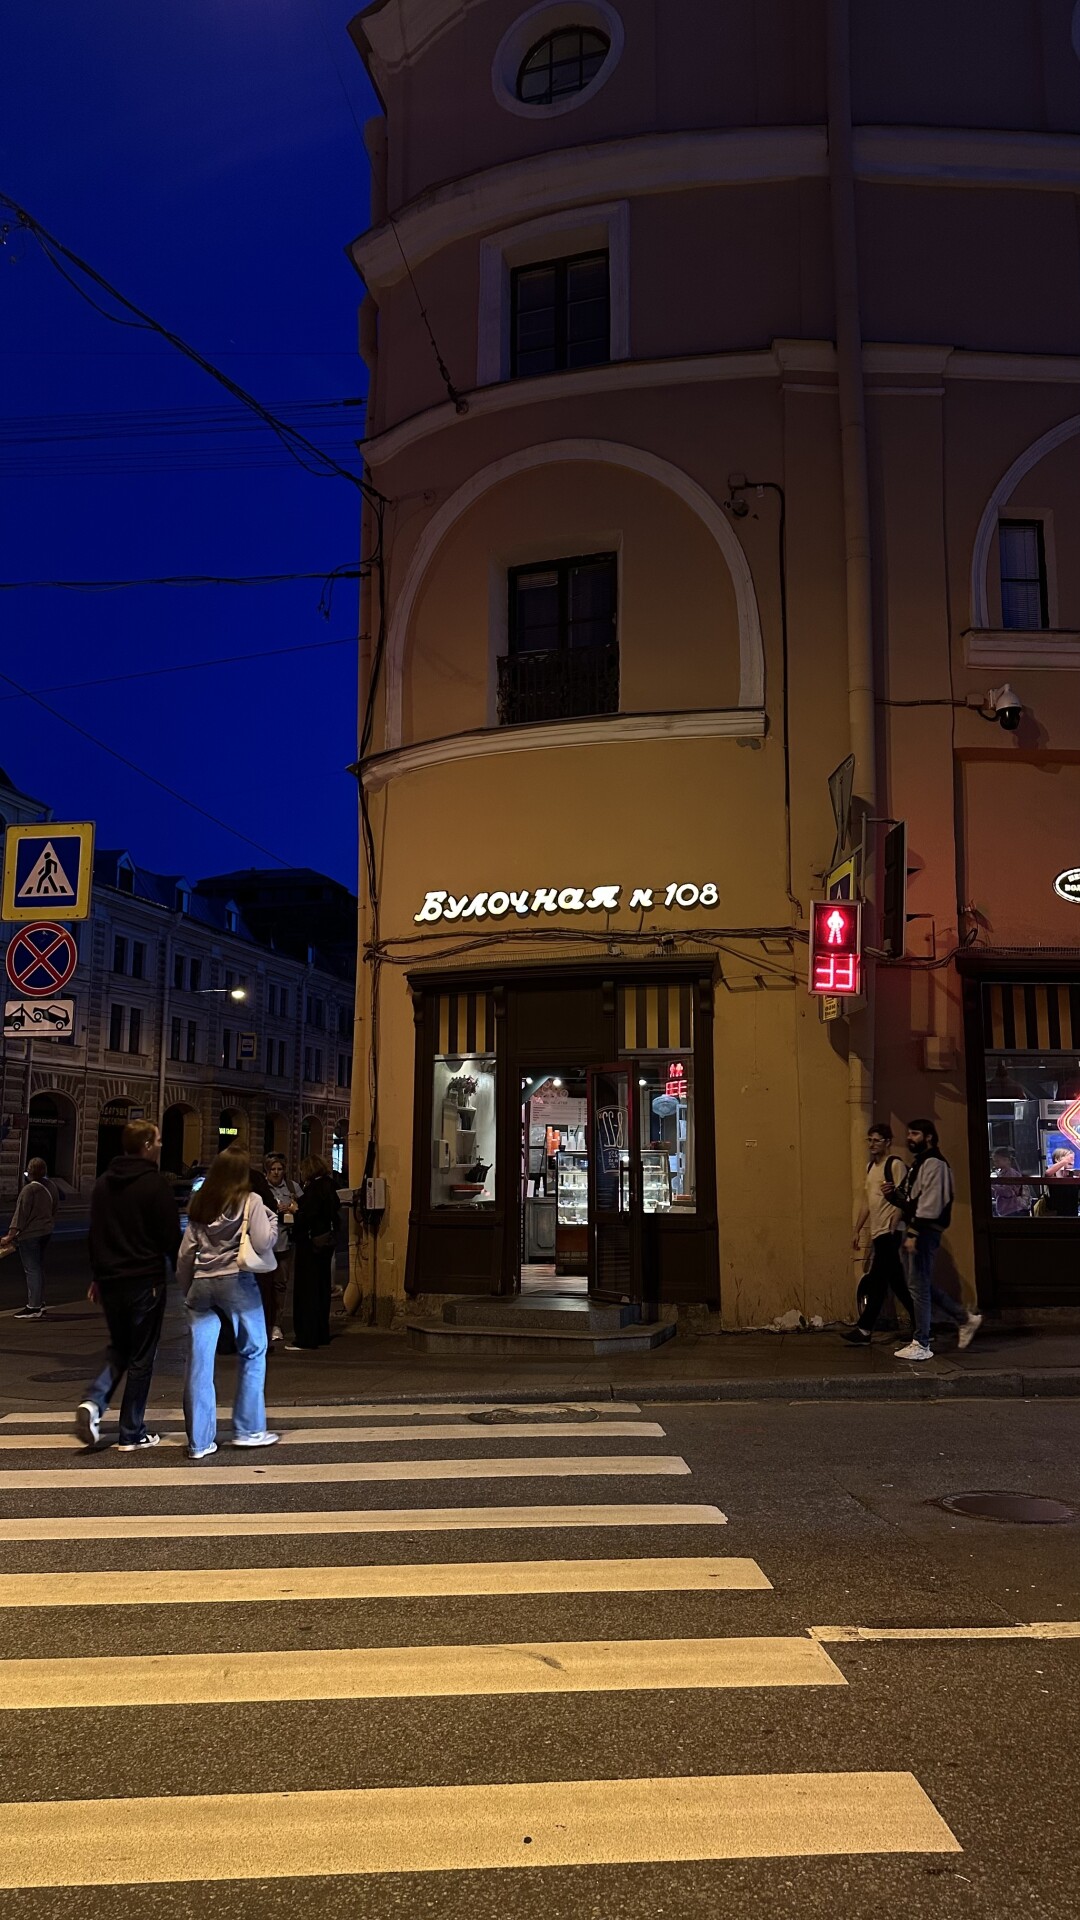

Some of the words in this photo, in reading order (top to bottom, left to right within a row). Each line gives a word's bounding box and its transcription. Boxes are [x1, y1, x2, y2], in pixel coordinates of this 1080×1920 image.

[414, 885, 620, 921] Булочная
[665, 882, 718, 906] 108
[816, 954, 853, 988] 33
